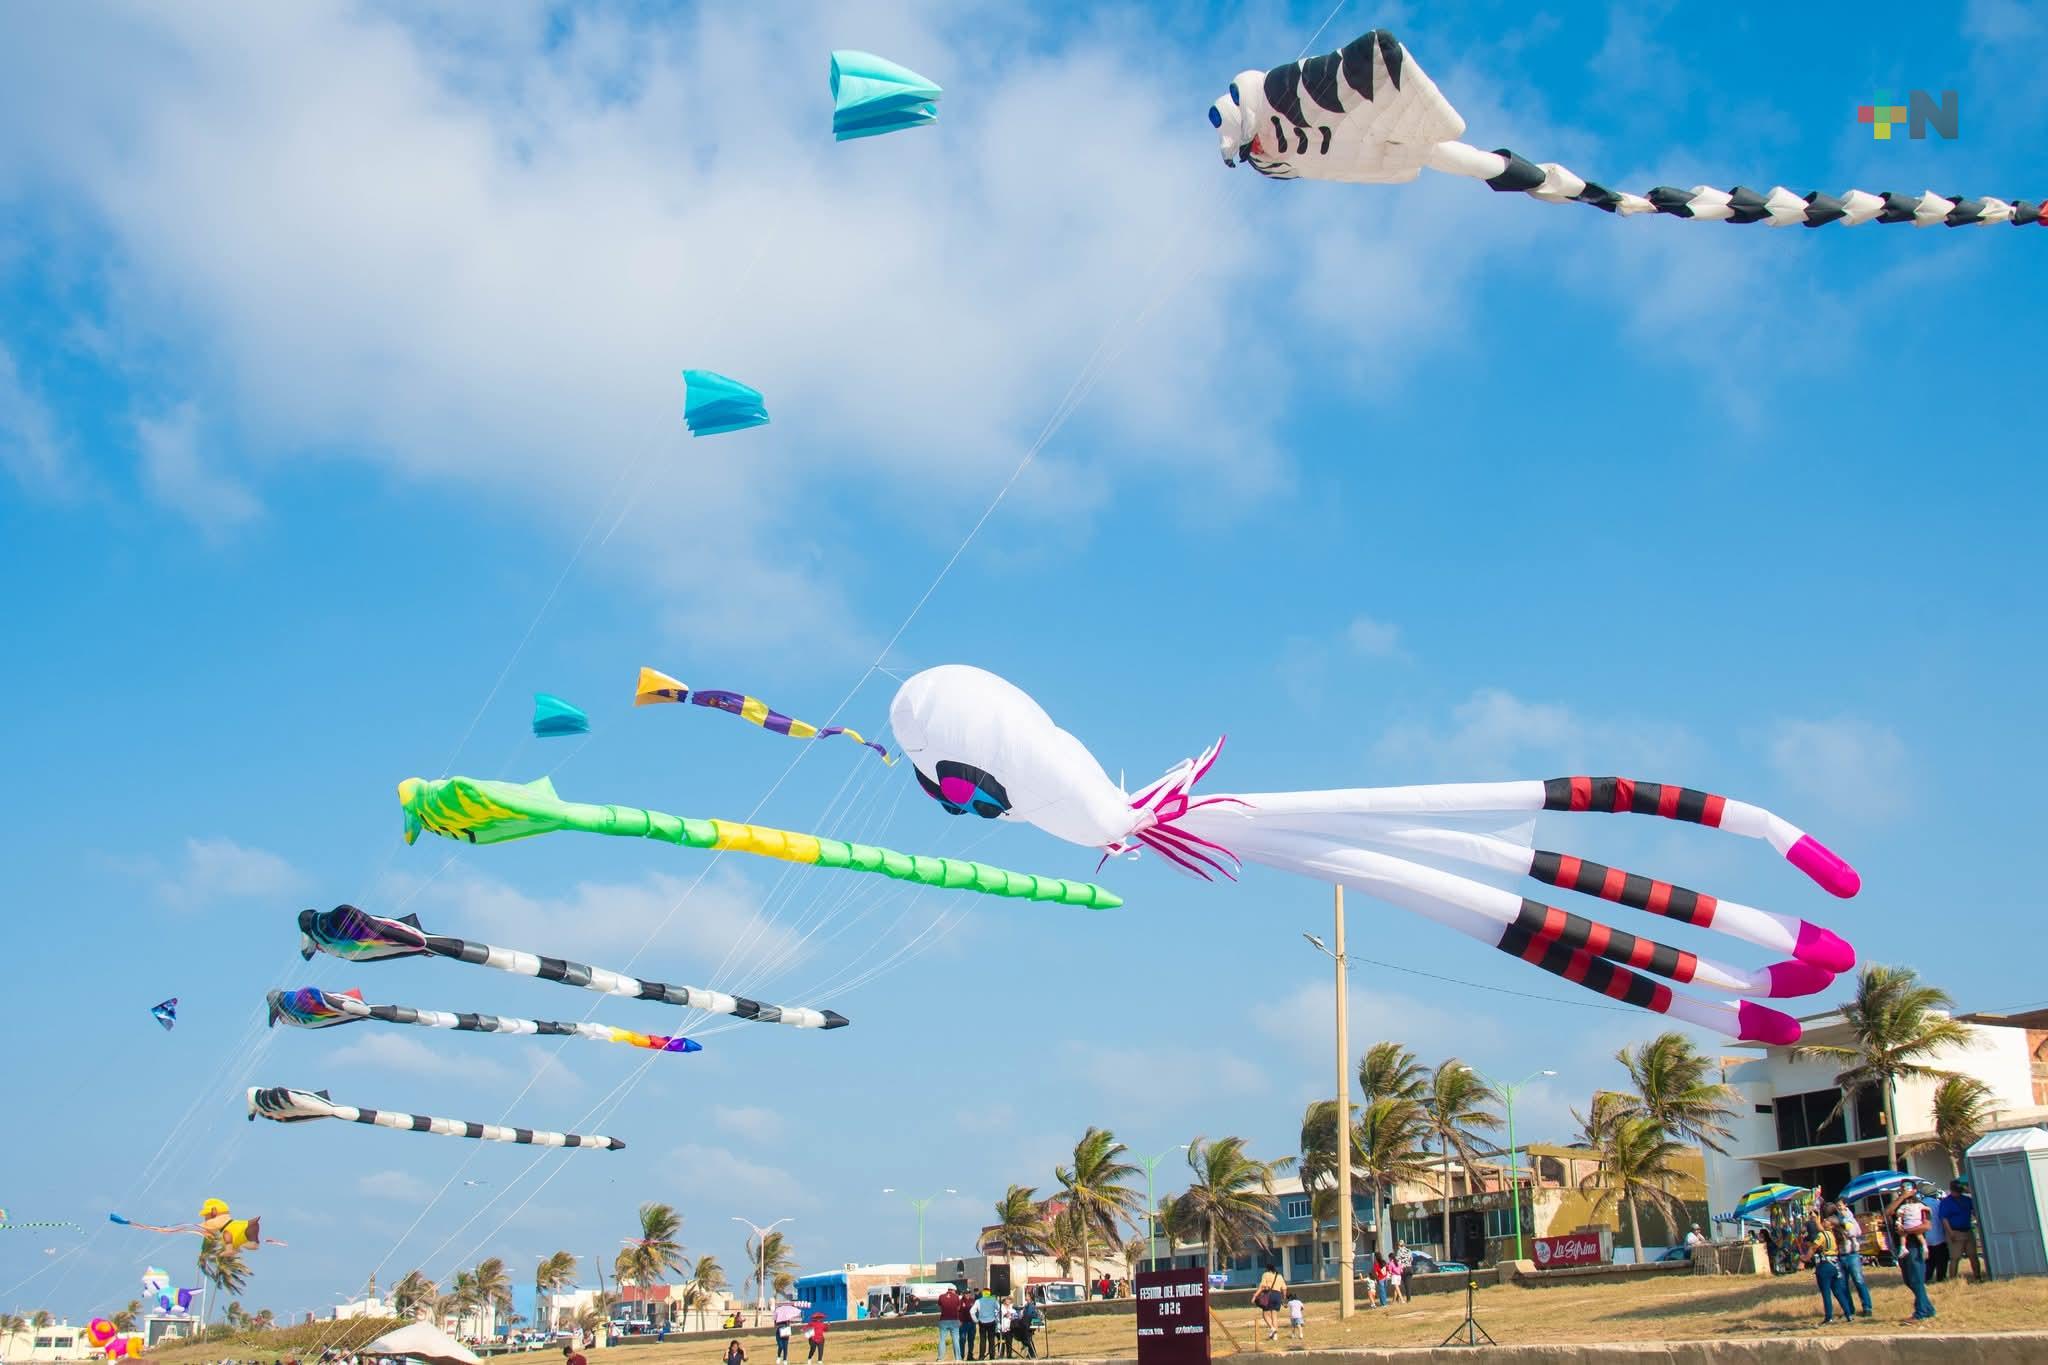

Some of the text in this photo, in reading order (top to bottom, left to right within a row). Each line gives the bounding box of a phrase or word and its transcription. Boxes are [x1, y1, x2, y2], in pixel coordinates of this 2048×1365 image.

[1553, 1240, 1564, 1258] La
[1164, 1285, 1175, 1298] DEL
[1159, 1302, 1181, 1316] 2026
